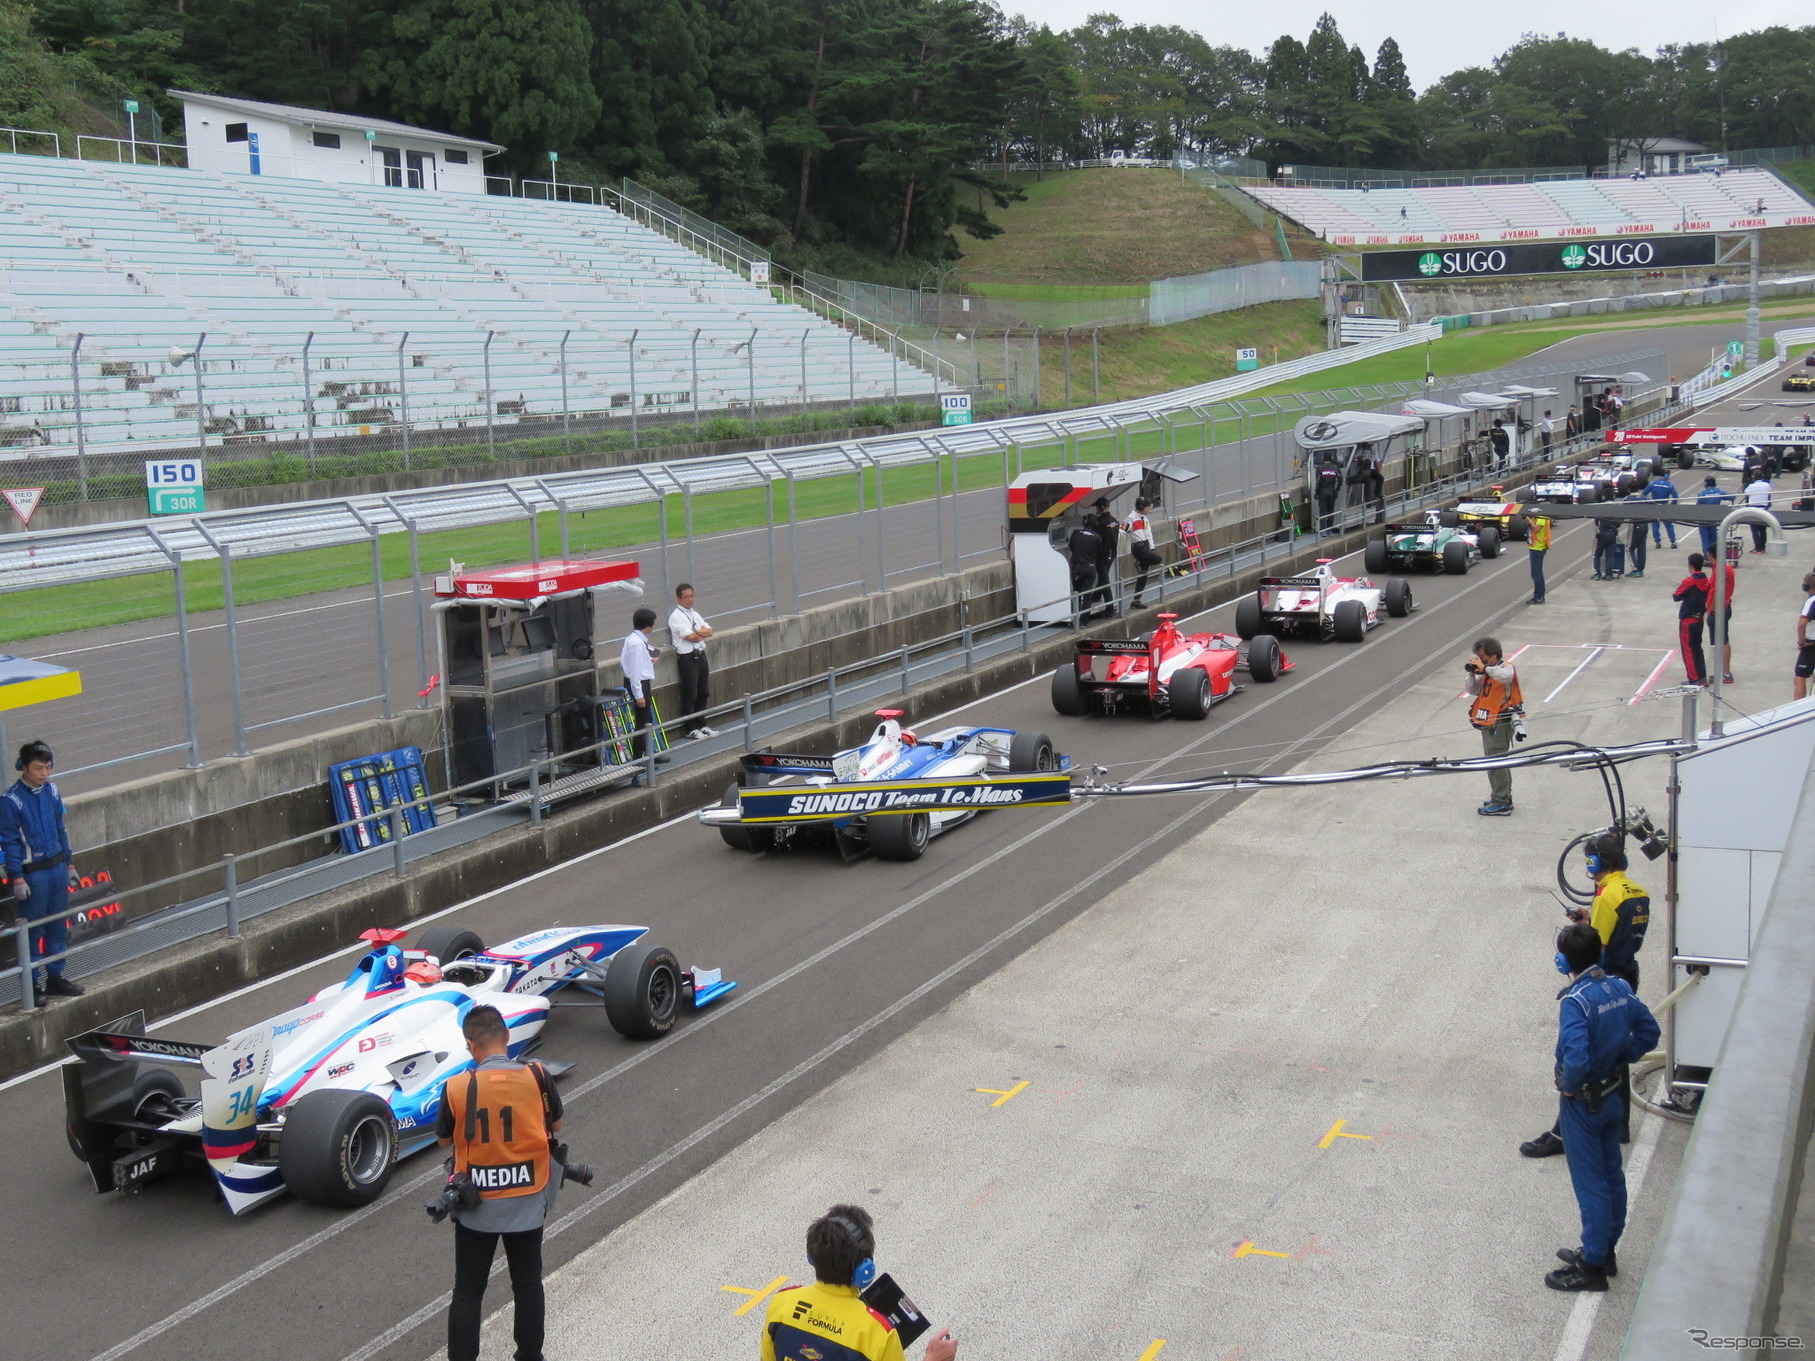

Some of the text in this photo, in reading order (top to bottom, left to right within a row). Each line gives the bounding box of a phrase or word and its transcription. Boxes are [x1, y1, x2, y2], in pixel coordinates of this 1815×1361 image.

[1736, 218, 1767, 228] YAMAHA
[1507, 229, 1539, 239] YAMAHA
[1566, 227, 1597, 236] YAMAHA
[1624, 224, 1655, 234] YAMAHA
[1335, 236, 1355, 244] YAMAHA
[1370, 236, 1388, 244] YAMAHA
[1402, 235, 1424, 243] YAMAHA
[1449, 232, 1480, 242] YAMAHA
[1586, 242, 1654, 267] SUGO
[1442, 249, 1506, 275] SUGO
[1242, 350, 1255, 358] 50
[944, 397, 968, 408] 100
[953, 415, 968, 424] 30R
[1613, 431, 1625, 442] 20
[152, 464, 196, 483] 150
[170, 497, 197, 511] 30R
[1102, 642, 1147, 650] YOKOHAMA
[776, 757, 833, 768] YOKOHAMA
[788, 792, 881, 815] SUNOCO
[879, 790, 938, 810] Team
[785, 826, 797, 837] JAF
[515, 977, 538, 994] TAKATA
[225, 1084, 254, 1125] 34
[476, 1105, 513, 1144] 11
[130, 1156, 157, 1179] JAF
[471, 1164, 531, 1188] MEDIA
[809, 1310, 846, 1327] SUPER
[807, 1316, 843, 1336] FORMULA
